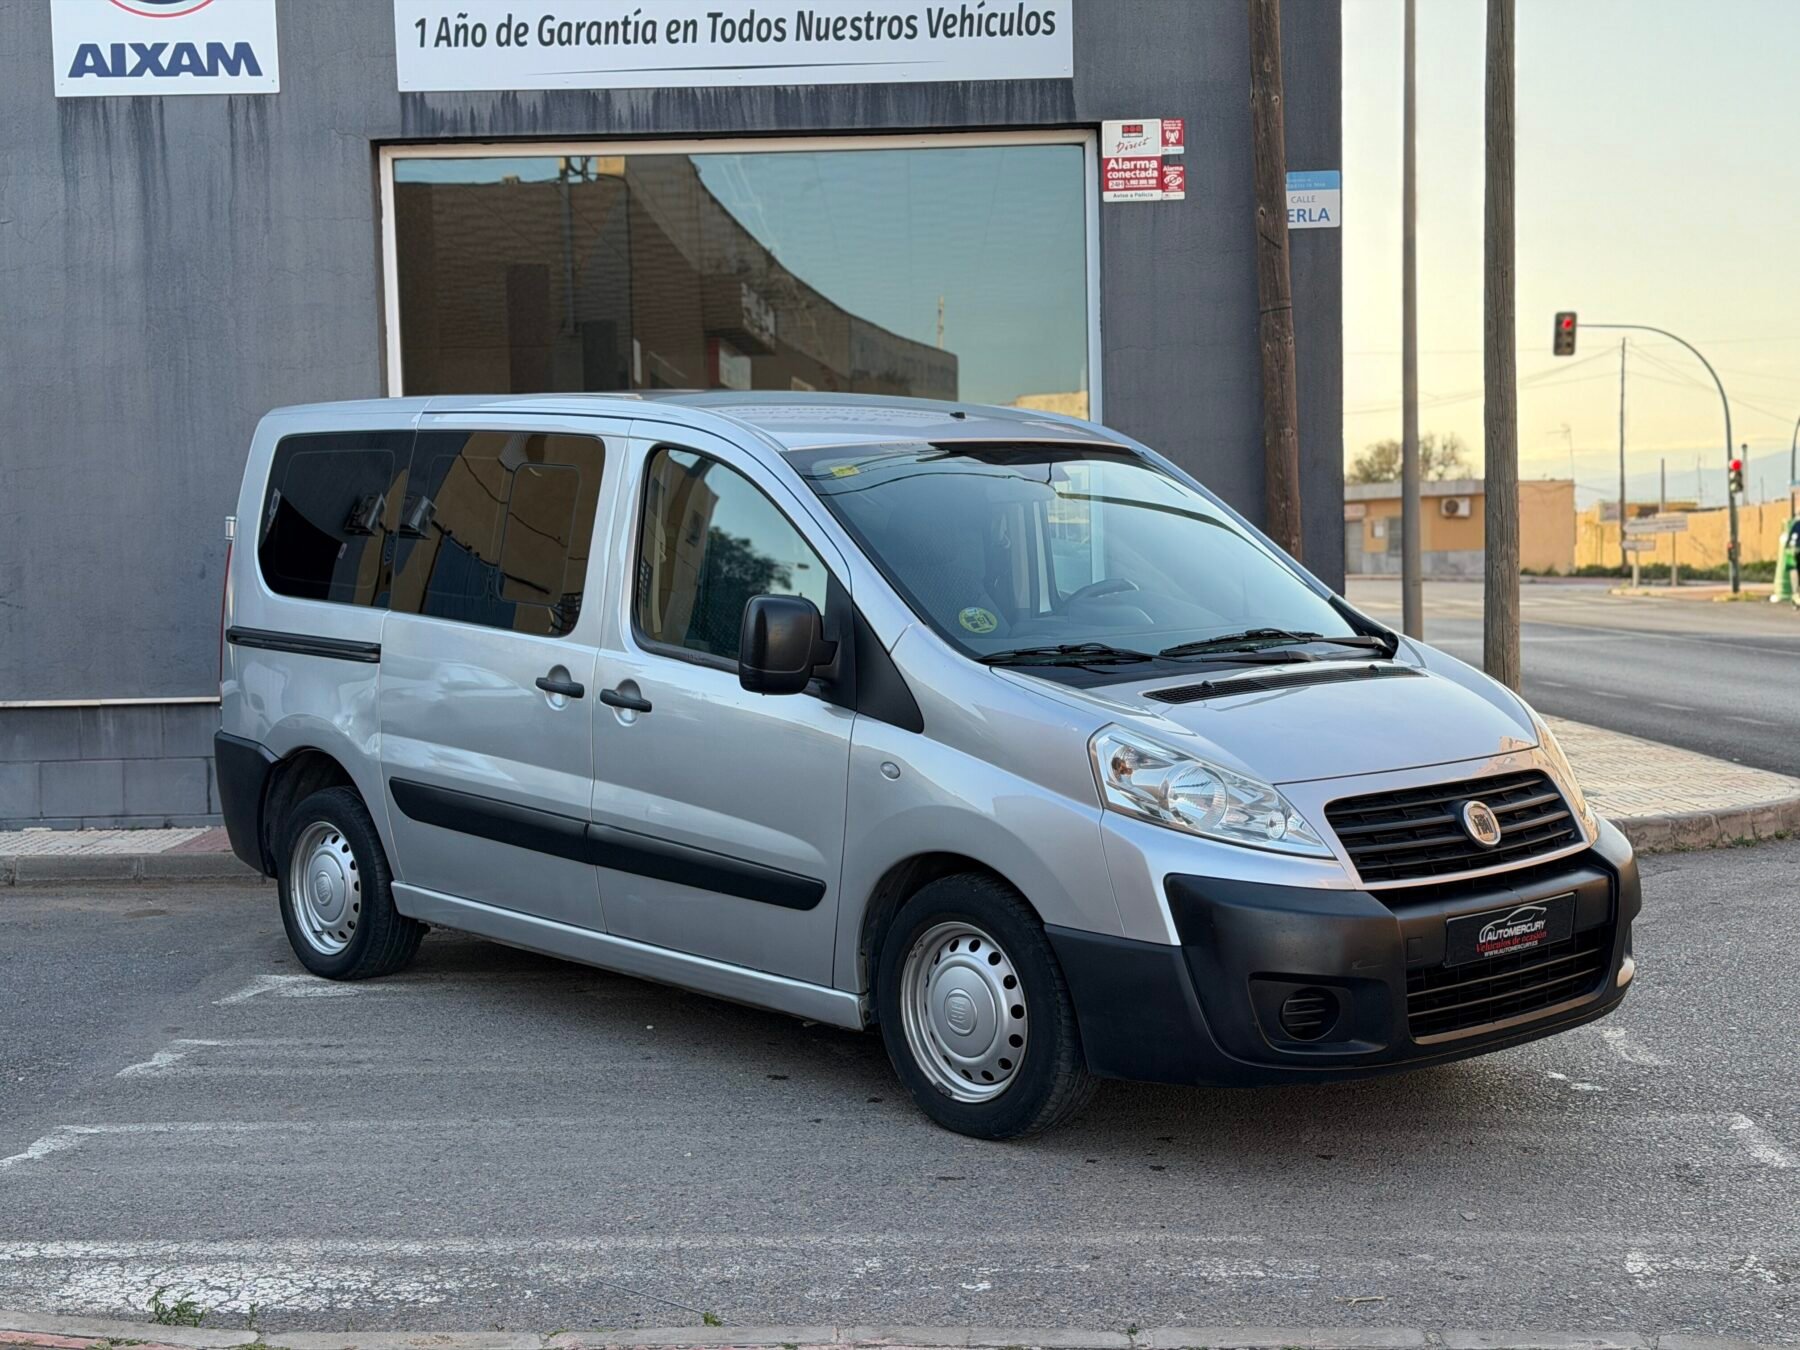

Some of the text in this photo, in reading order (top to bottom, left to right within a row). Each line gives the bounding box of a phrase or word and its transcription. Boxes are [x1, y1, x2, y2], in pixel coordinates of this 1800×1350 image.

[414, 1, 1056, 48] 1 Año de Garantía en Todos Nuestros Vehículos
[67, 42, 264, 78] AIXAM
[1107, 158, 1158, 170] Alarma
[1107, 169, 1158, 179] conectada
[1290, 195, 1317, 204] CALLE
[1287, 207, 1331, 223] ERLA
[1486, 919, 1546, 941] AUTOMERCURY
